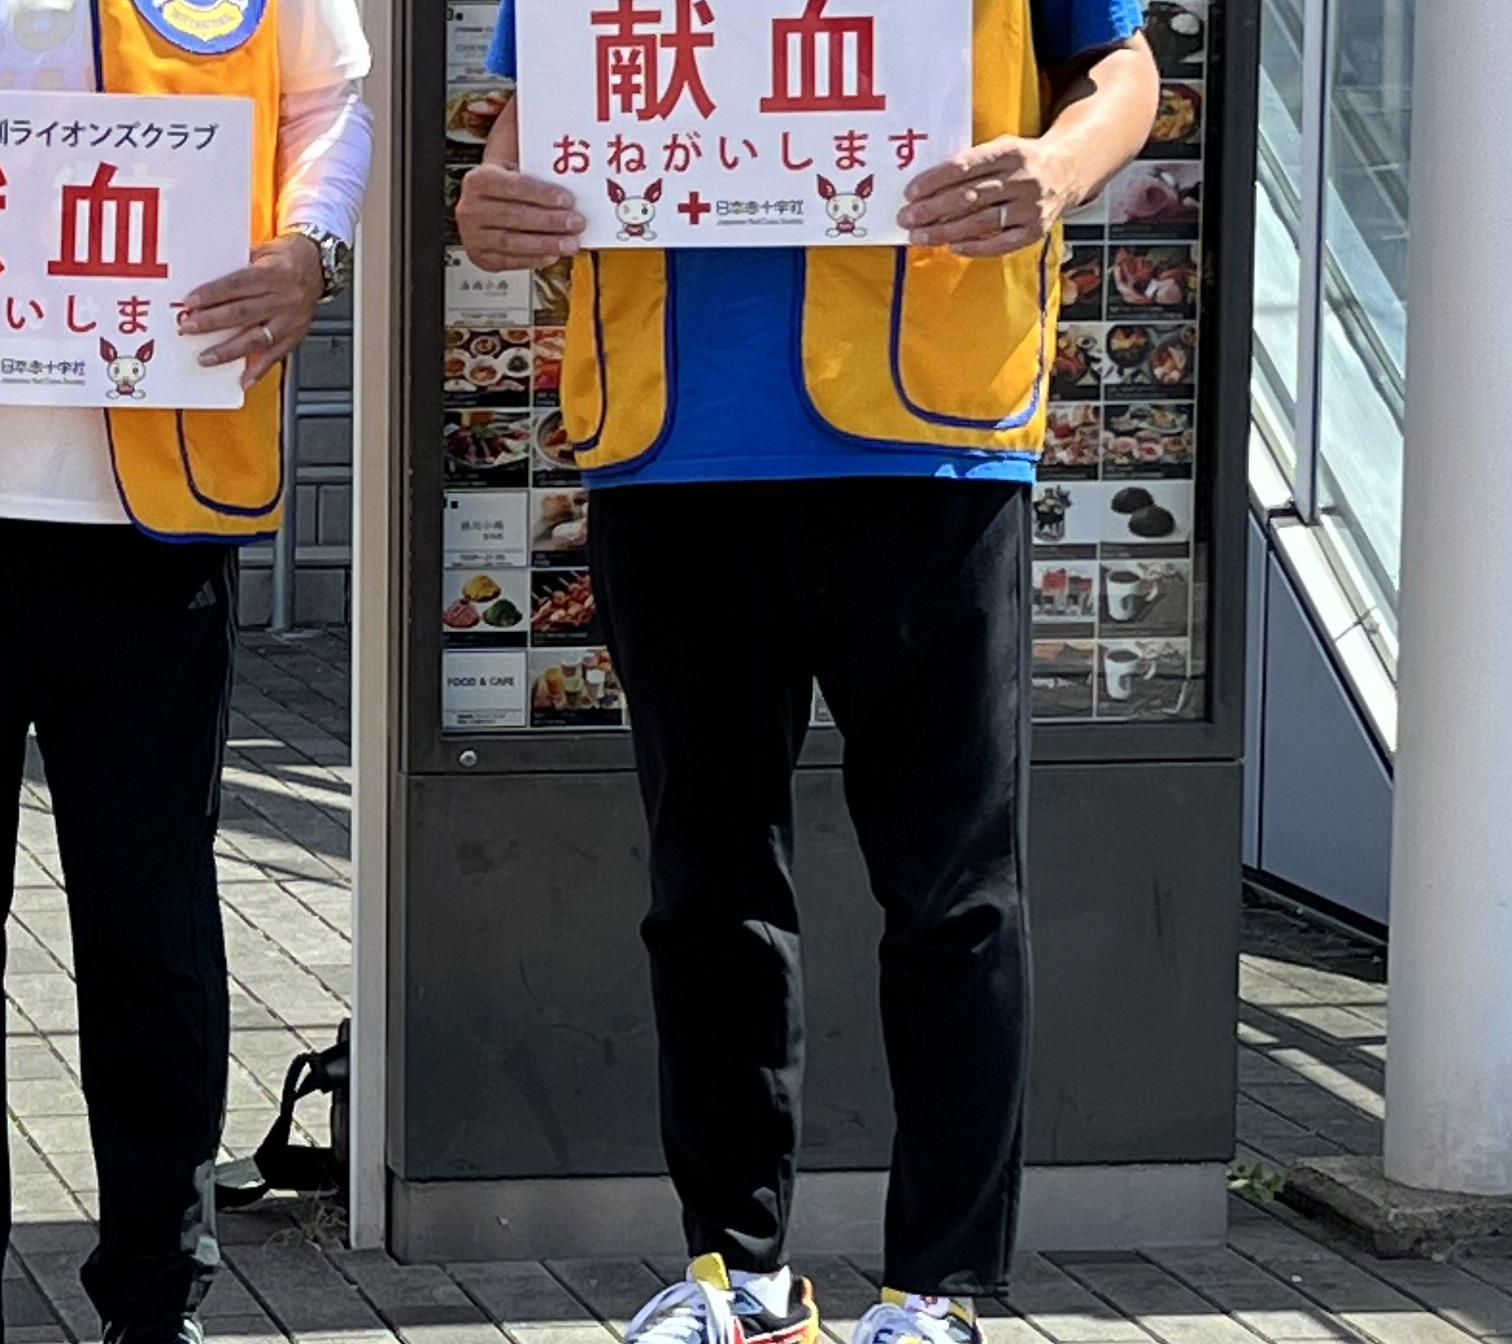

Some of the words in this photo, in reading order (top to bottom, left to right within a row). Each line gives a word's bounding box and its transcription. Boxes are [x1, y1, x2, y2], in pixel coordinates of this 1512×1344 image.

[552, 129, 928, 174] おねがいします
[447, 677, 477, 687] FOOD
[489, 677, 514, 687] CAFE
